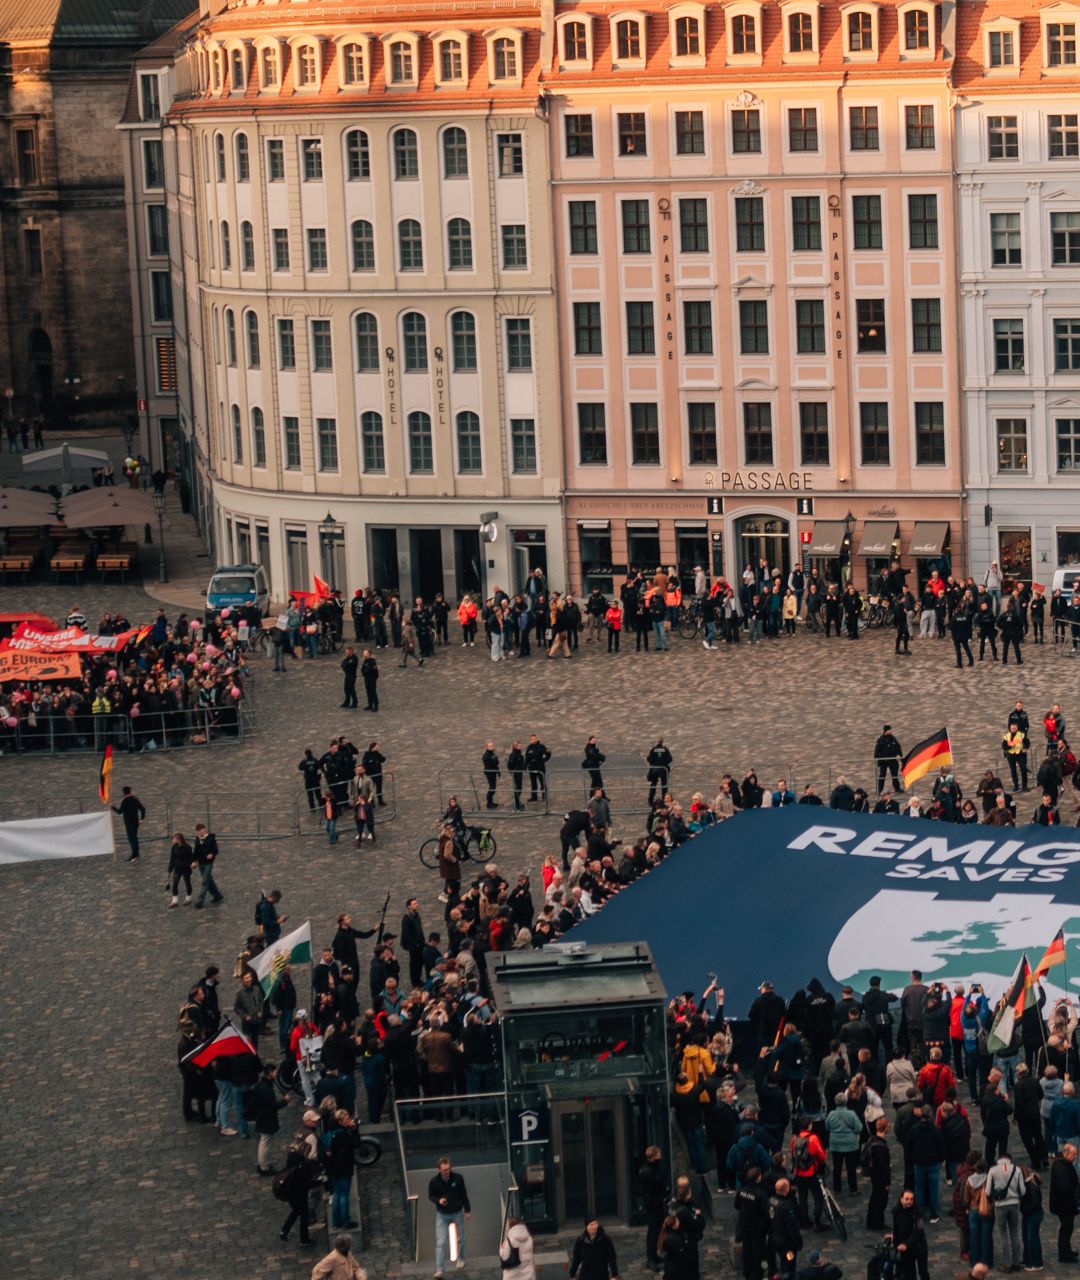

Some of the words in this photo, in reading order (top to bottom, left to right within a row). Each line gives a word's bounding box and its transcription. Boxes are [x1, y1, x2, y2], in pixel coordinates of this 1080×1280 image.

[662, 235, 673, 360] PASSAGE
[832, 232, 843, 359] PASSAGE
[387, 368, 397, 425] HOTEL
[436, 368, 446, 425] HOTEL
[721, 471, 813, 490] PASSAGE
[745, 522, 784, 531] PAAGE
[24, 628, 76, 643] UNSERE
[12, 654, 72, 666] EUROPA?
[886, 862, 1067, 884] SAVES
[521, 1115, 539, 1141] P
